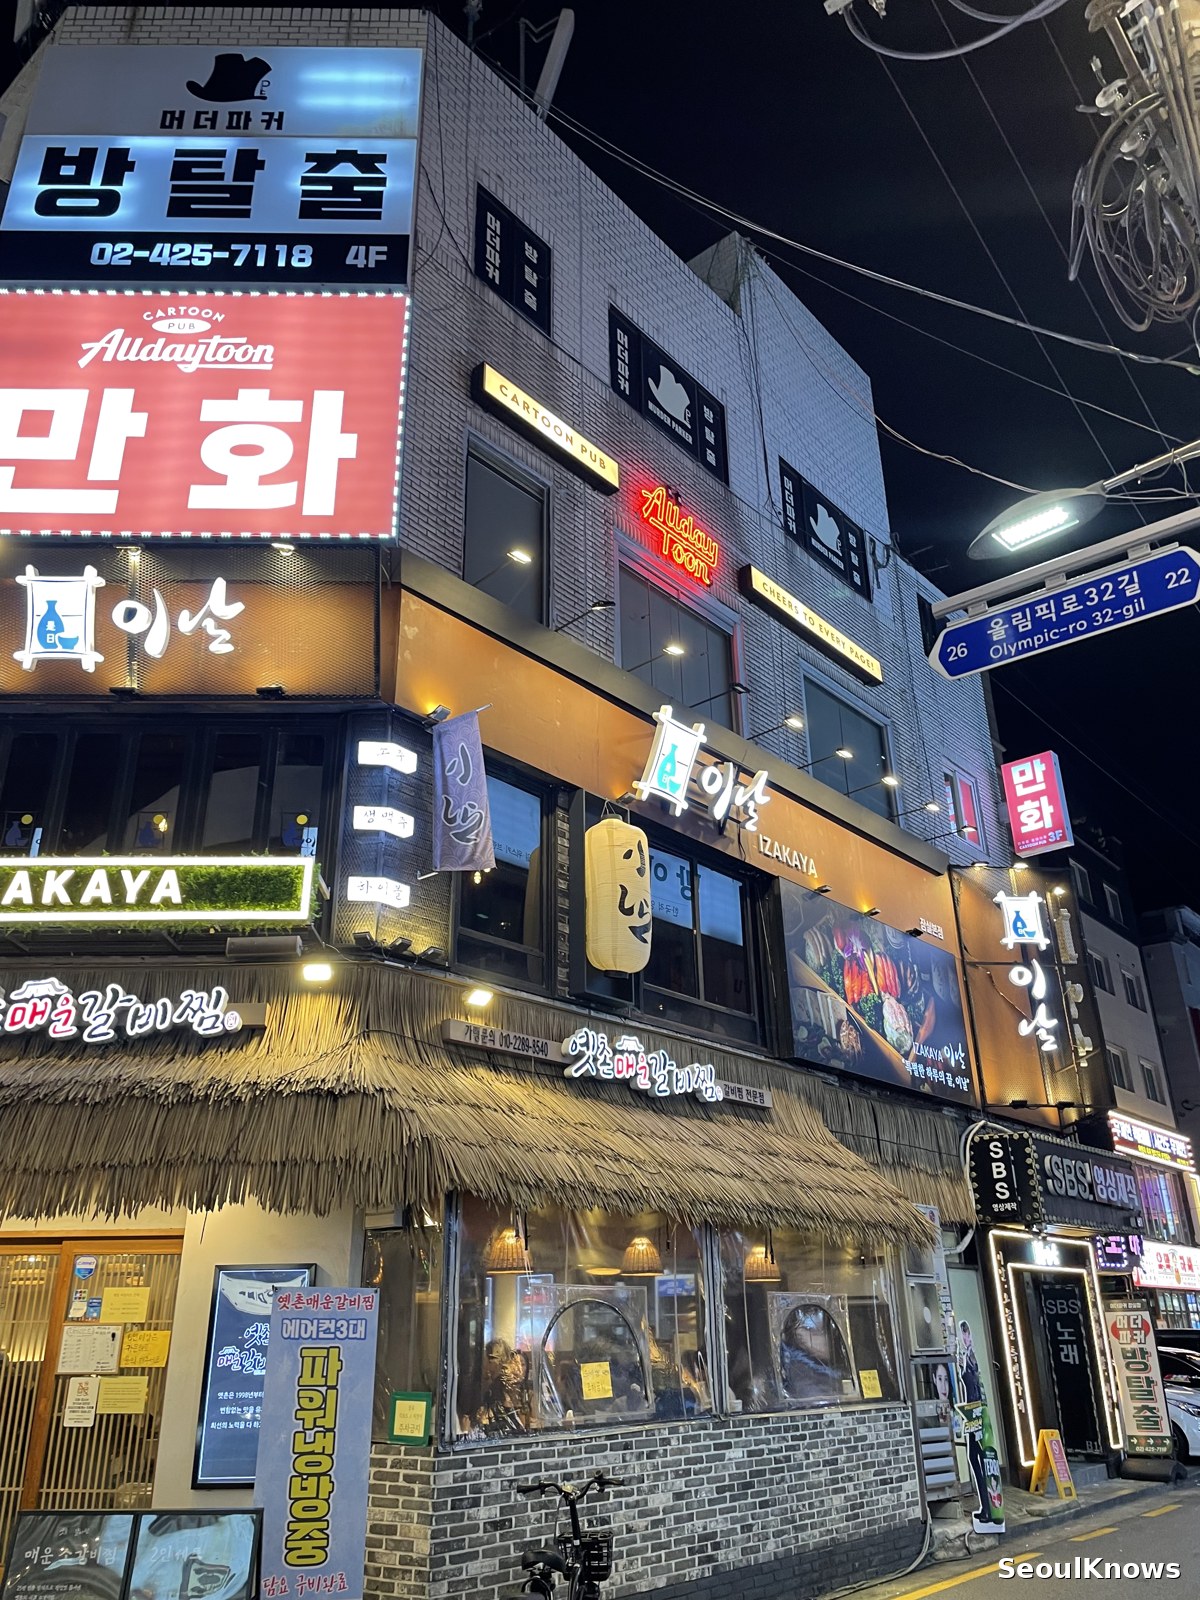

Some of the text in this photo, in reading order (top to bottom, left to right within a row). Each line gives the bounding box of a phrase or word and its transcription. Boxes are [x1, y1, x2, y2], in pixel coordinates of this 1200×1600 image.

[160, 111, 284, 130] 머더파커
[34, 147, 388, 220] 방탈출
[90, 242, 388, 268] 02-425-7118 4F
[143, 306, 225, 322] CARTOON
[167, 321, 196, 331] PUB
[499, 384, 606, 470] CARTOON PUB
[0, 388, 358, 516] 만화
[1165, 568, 1191, 590] 22
[987, 571, 1141, 641] 올림픽로32길
[762, 583, 875, 671] CHEERS TO EVERY PAGE!
[990, 597, 1146, 659] Olympic-ro 32-gil
[947, 643, 968, 661] 26
[1011, 758, 1054, 834] 만화
[1048, 830, 1062, 842] 3F
[758, 834, 818, 879] IZAKAYA
[2, 869, 182, 905] AKAYA
[0, 984, 229, 1042] 매운갈비찜
[465, 1025, 495, 1046] 가맹문의
[912, 1042, 944, 1062] IZAKAYA
[989, 1142, 1010, 1200] SBS
[1094, 1165, 1138, 1206] 영상제작
[992, 1202, 1017, 1212] 영상제작
[277, 1293, 375, 1311] 옛촌매운갈비찜
[1046, 1299, 1080, 1314] SBS
[281, 1318, 367, 1341] 에어컨3대
[1116, 1315, 1142, 1329] 머더
[1056, 1321, 1079, 1365] 노래
[1119, 1330, 1146, 1344] 파커
[1121, 1347, 1163, 1432] 방탈출
[284, 1346, 343, 1568] 파워냉방중
[24, 1546, 52, 1565] 매운
[262, 1572, 349, 1597] 담요 구비완료
